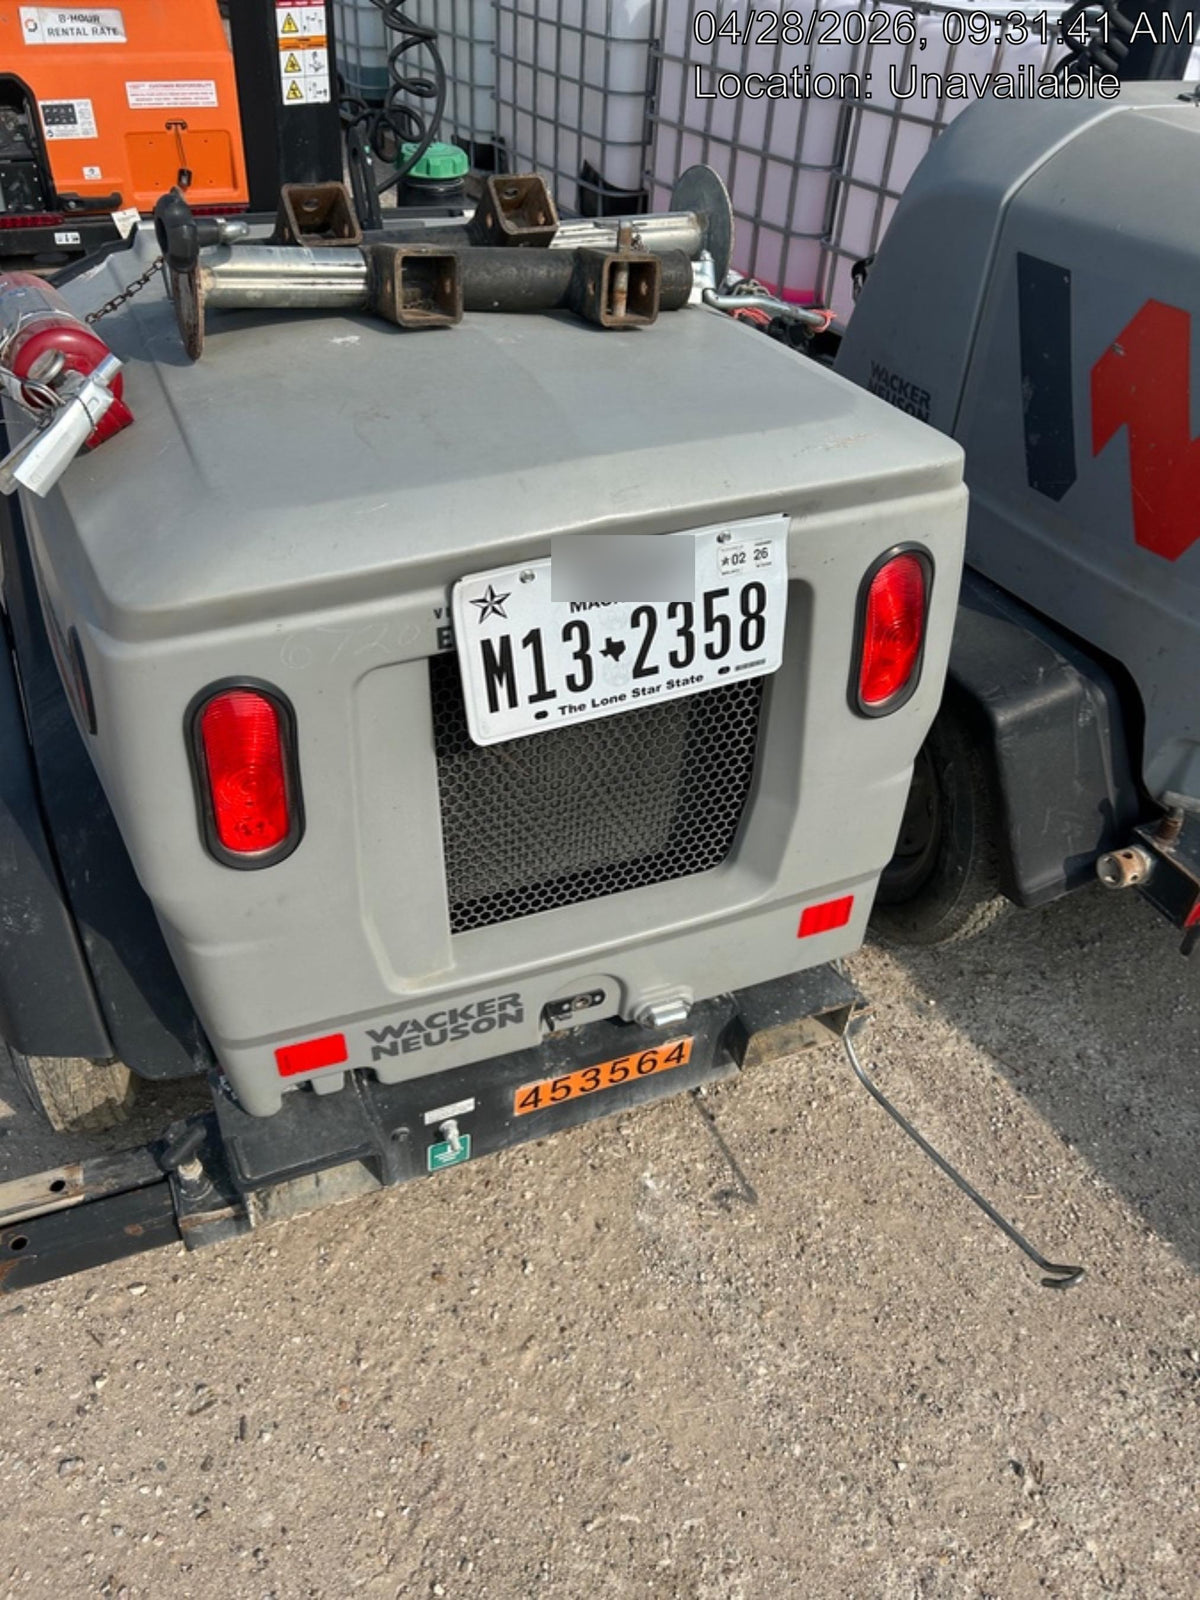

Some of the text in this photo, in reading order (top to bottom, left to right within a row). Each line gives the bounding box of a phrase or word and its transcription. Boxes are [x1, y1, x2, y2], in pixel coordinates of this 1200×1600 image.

[47, 26, 119, 37] RENTAL RATE
[871, 360, 931, 410] WACKER
[753, 547, 769, 560] 26
[558, 674, 704, 716] The Lone Star State
[365, 992, 523, 1043] WACKER
[371, 1007, 524, 1062] NEUSON
[518, 1040, 686, 1110] 453564
